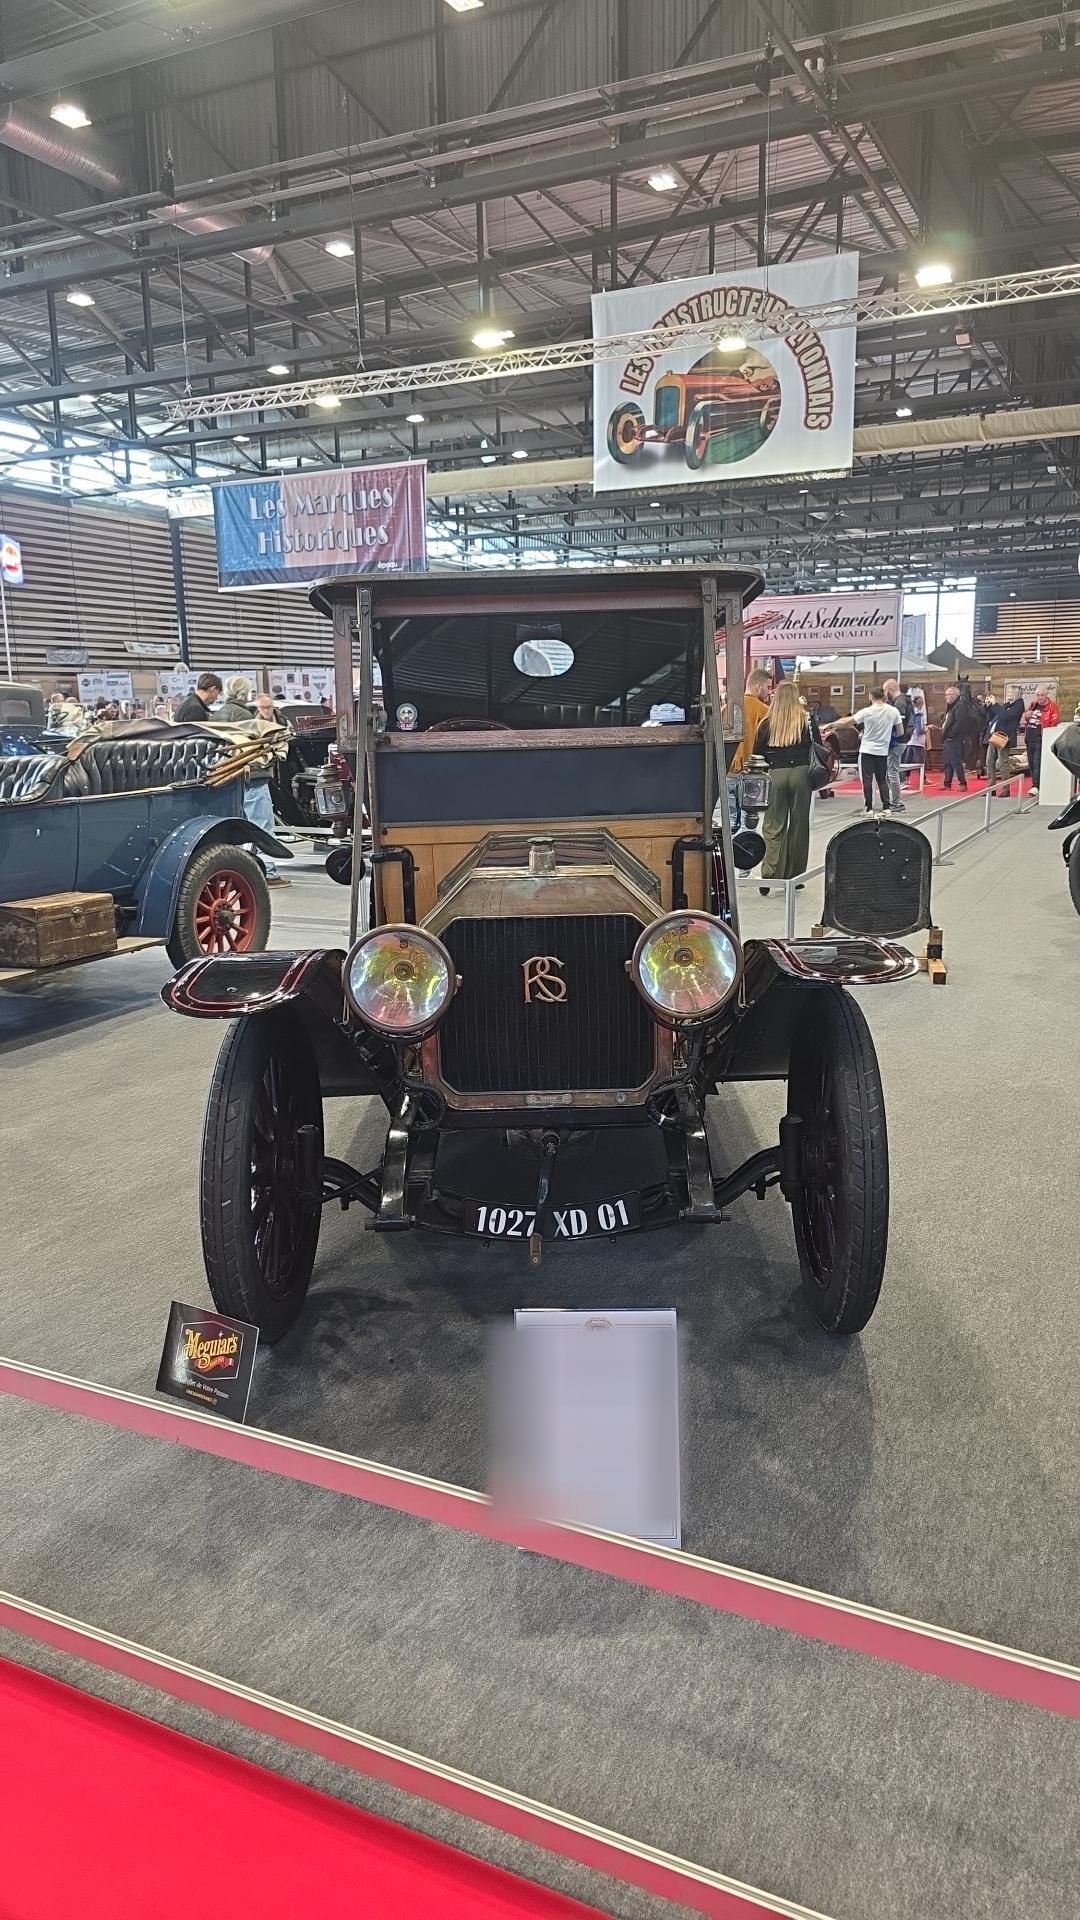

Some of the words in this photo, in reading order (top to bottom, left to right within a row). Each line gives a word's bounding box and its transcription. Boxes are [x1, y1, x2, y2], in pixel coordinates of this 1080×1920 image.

[621, 356, 653, 394] LES
[786, 320, 833, 430] LYONNAIS
[250, 497, 286, 520] Les
[294, 487, 393, 517] Marques
[257, 524, 388, 555] Historiques
[477, 1206, 537, 1237] 1027
[553, 1209, 588, 1238] XD
[597, 1200, 629, 1231] 01
[182, 1328, 238, 1369] Meguiar's
